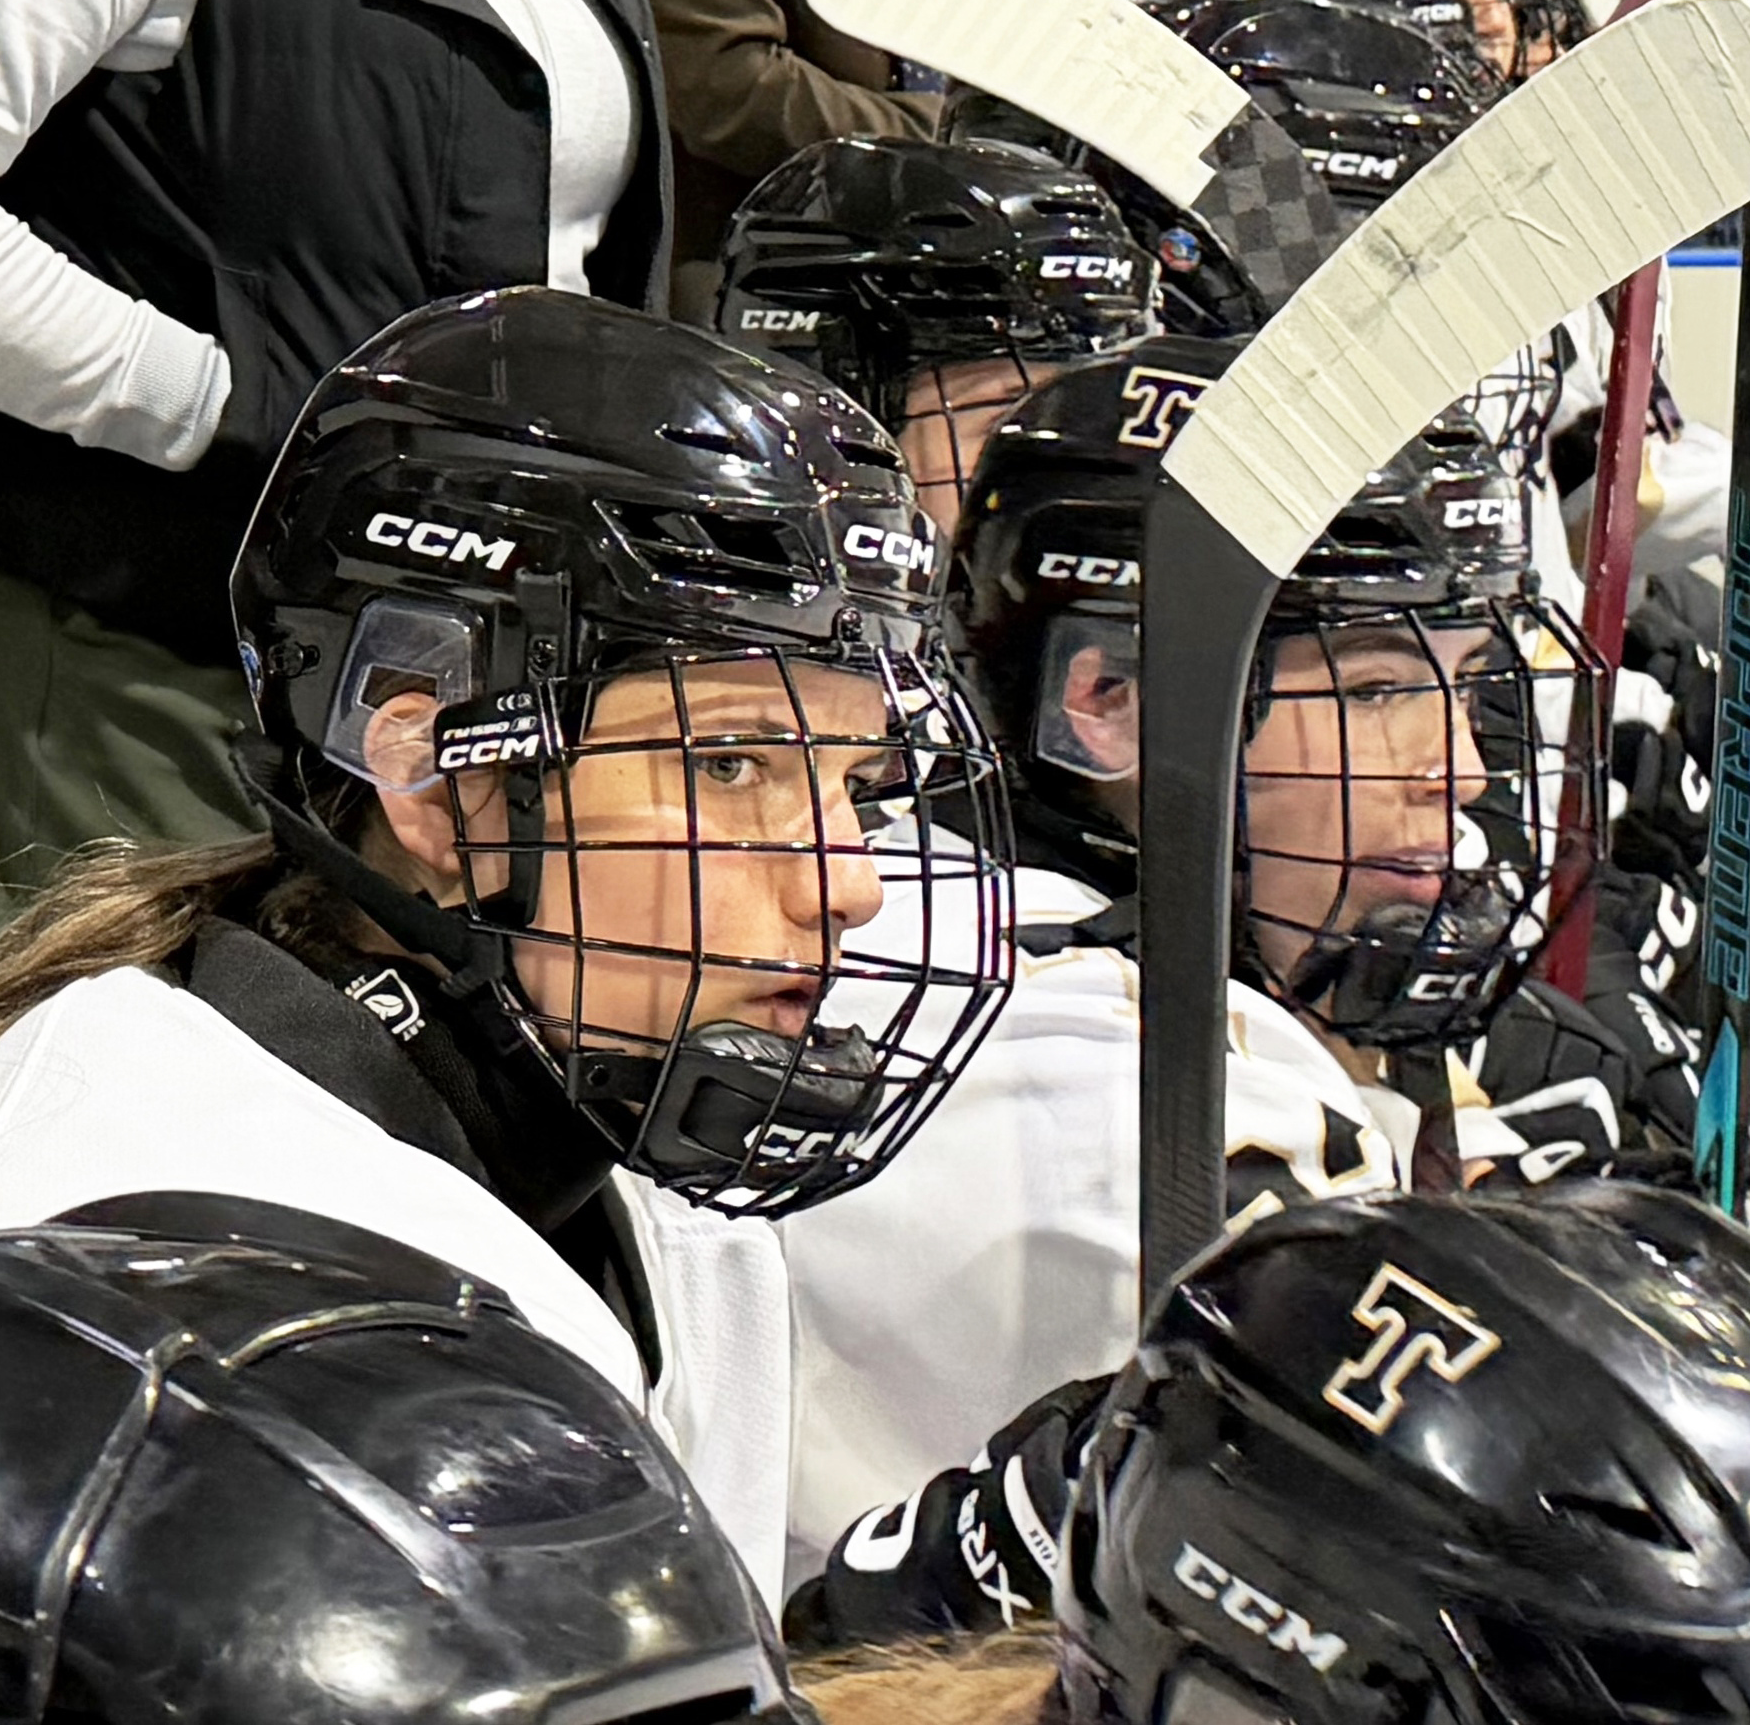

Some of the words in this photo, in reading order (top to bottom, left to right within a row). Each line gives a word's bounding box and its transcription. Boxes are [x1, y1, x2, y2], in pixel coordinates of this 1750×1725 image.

[1039, 254, 1134, 282] CCM
[741, 308, 820, 332] CCM
[365, 512, 517, 571] CCM
[843, 524, 935, 575] CCM
[438, 734, 540, 770] CCM
[1321, 1259, 1503, 1436] T
[1173, 1541, 1349, 1673] CCM
